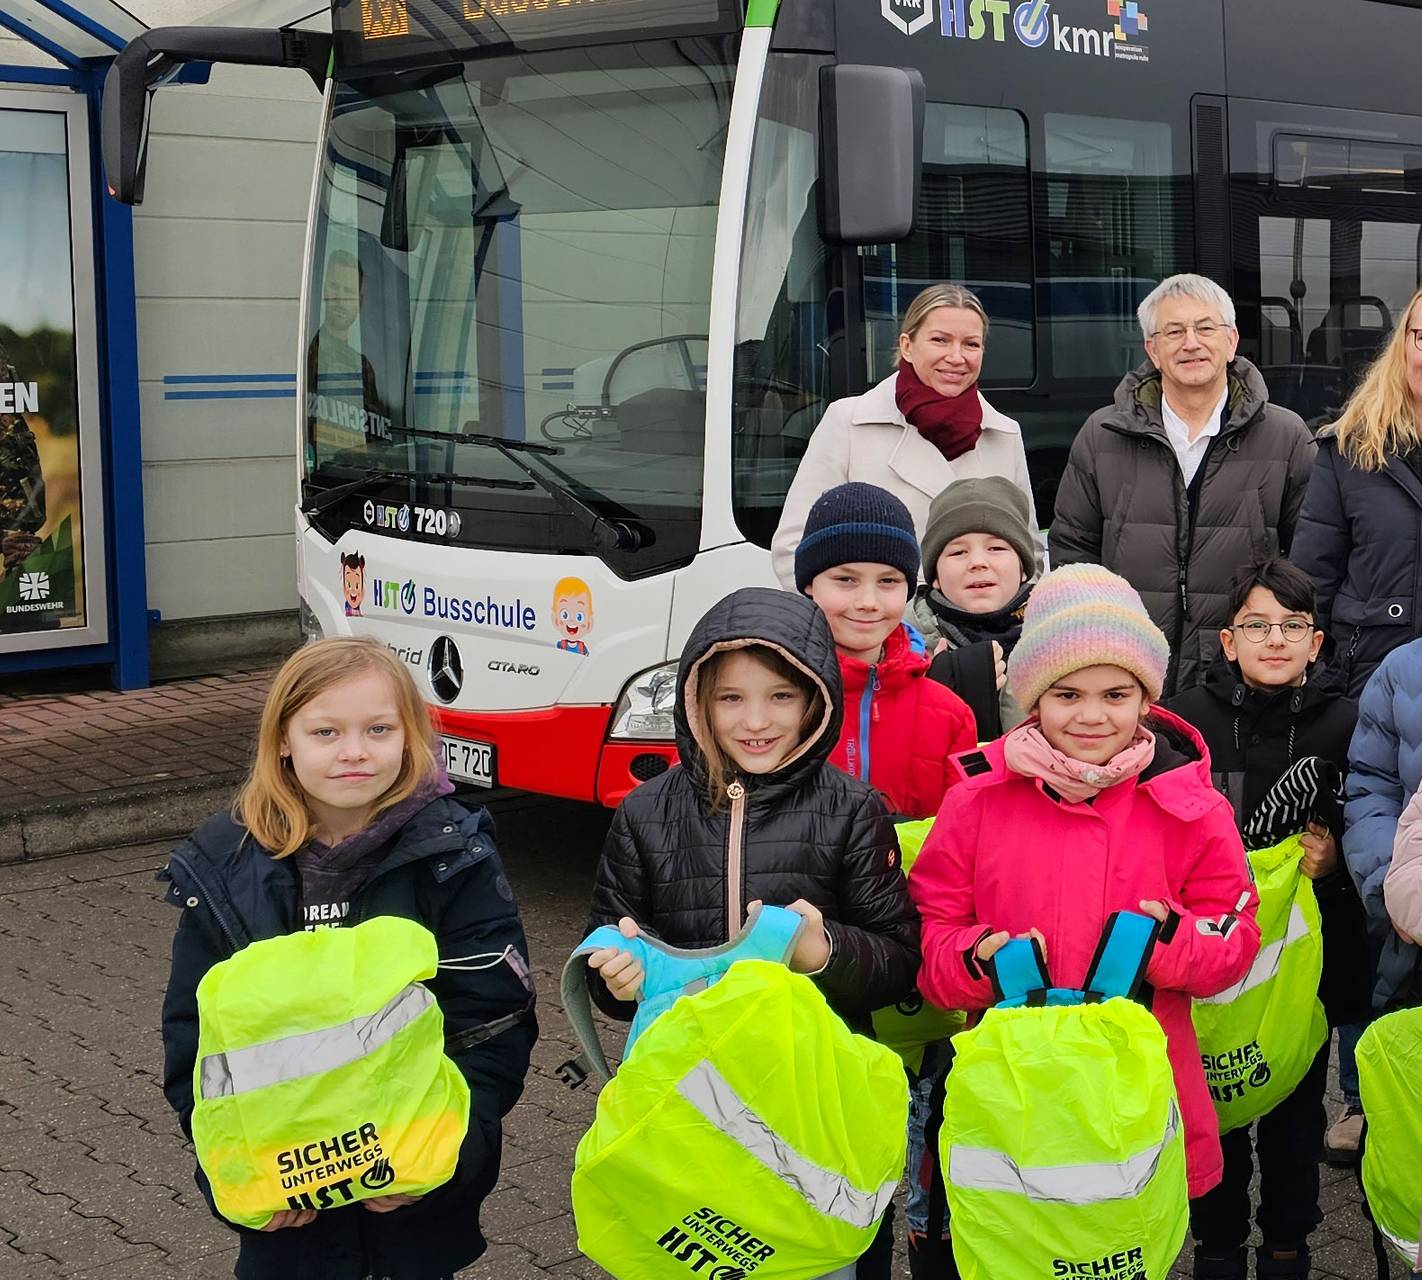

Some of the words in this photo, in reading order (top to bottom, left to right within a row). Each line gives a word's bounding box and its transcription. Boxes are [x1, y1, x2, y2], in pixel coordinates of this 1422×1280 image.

[940, 0, 1010, 41] HST
[1053, 14, 1114, 57] kmr
[414, 507, 447, 535] 720
[6, 602, 64, 613] BUNDESWEHR
[374, 579, 399, 610] HST
[424, 587, 536, 630] Busschule
[462, 745, 492, 778] 720
[277, 1122, 379, 1174] SICHER
[282, 1144, 383, 1189] UNTERWEGS
[287, 1178, 354, 1210] HST
[656, 1226, 718, 1272] HST
[682, 1215, 759, 1271] UNTERWEGS
[693, 1207, 775, 1262] SICHER
[1053, 1247, 1143, 1276] SICHER
